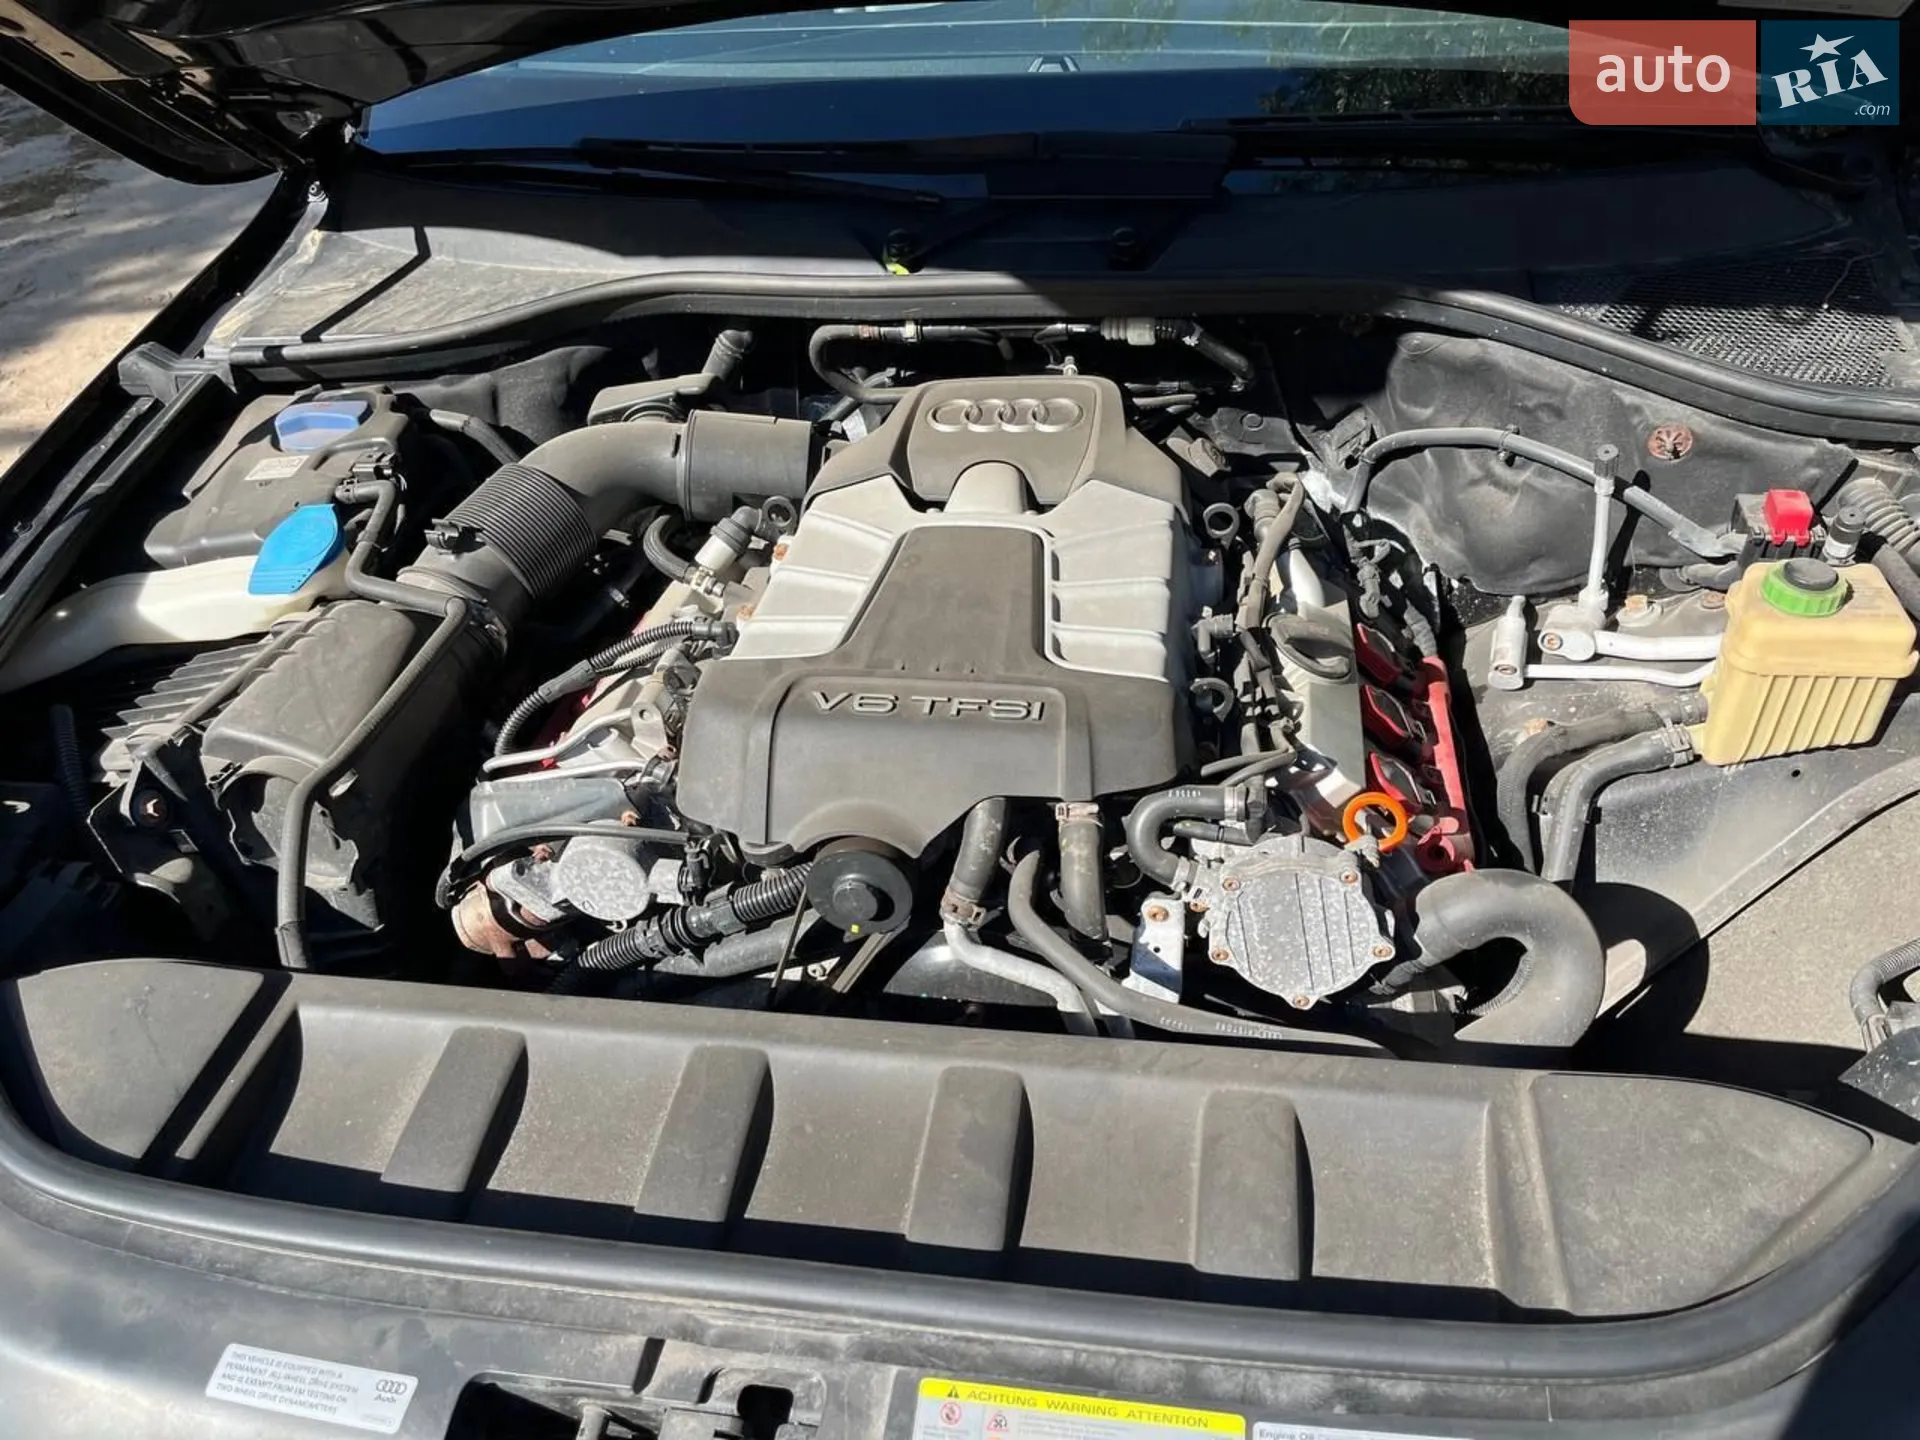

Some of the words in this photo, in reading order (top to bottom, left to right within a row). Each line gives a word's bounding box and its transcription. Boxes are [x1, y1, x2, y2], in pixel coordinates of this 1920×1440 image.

[812, 690, 899, 715] V6
[911, 695, 1046, 722] TFSI
[226, 1362, 268, 1377] PERMANENT
[329, 1381, 359, 1393] SYSTEM
[282, 1361, 318, 1375] EQUIPPED
[244, 1376, 274, 1388] EXEMPT
[274, 1382, 294, 1393] FROM
[306, 1389, 336, 1402] TESTING
[373, 1394, 397, 1404] Audi
[967, 1389, 1038, 1407] ACHTUNG
[1046, 1399, 1117, 1418] WARNING
[1126, 1408, 1209, 1428] ATTENTION
[1259, 1428, 1296, 1440] Engine
[1299, 1430, 1316, 1440] Oil
